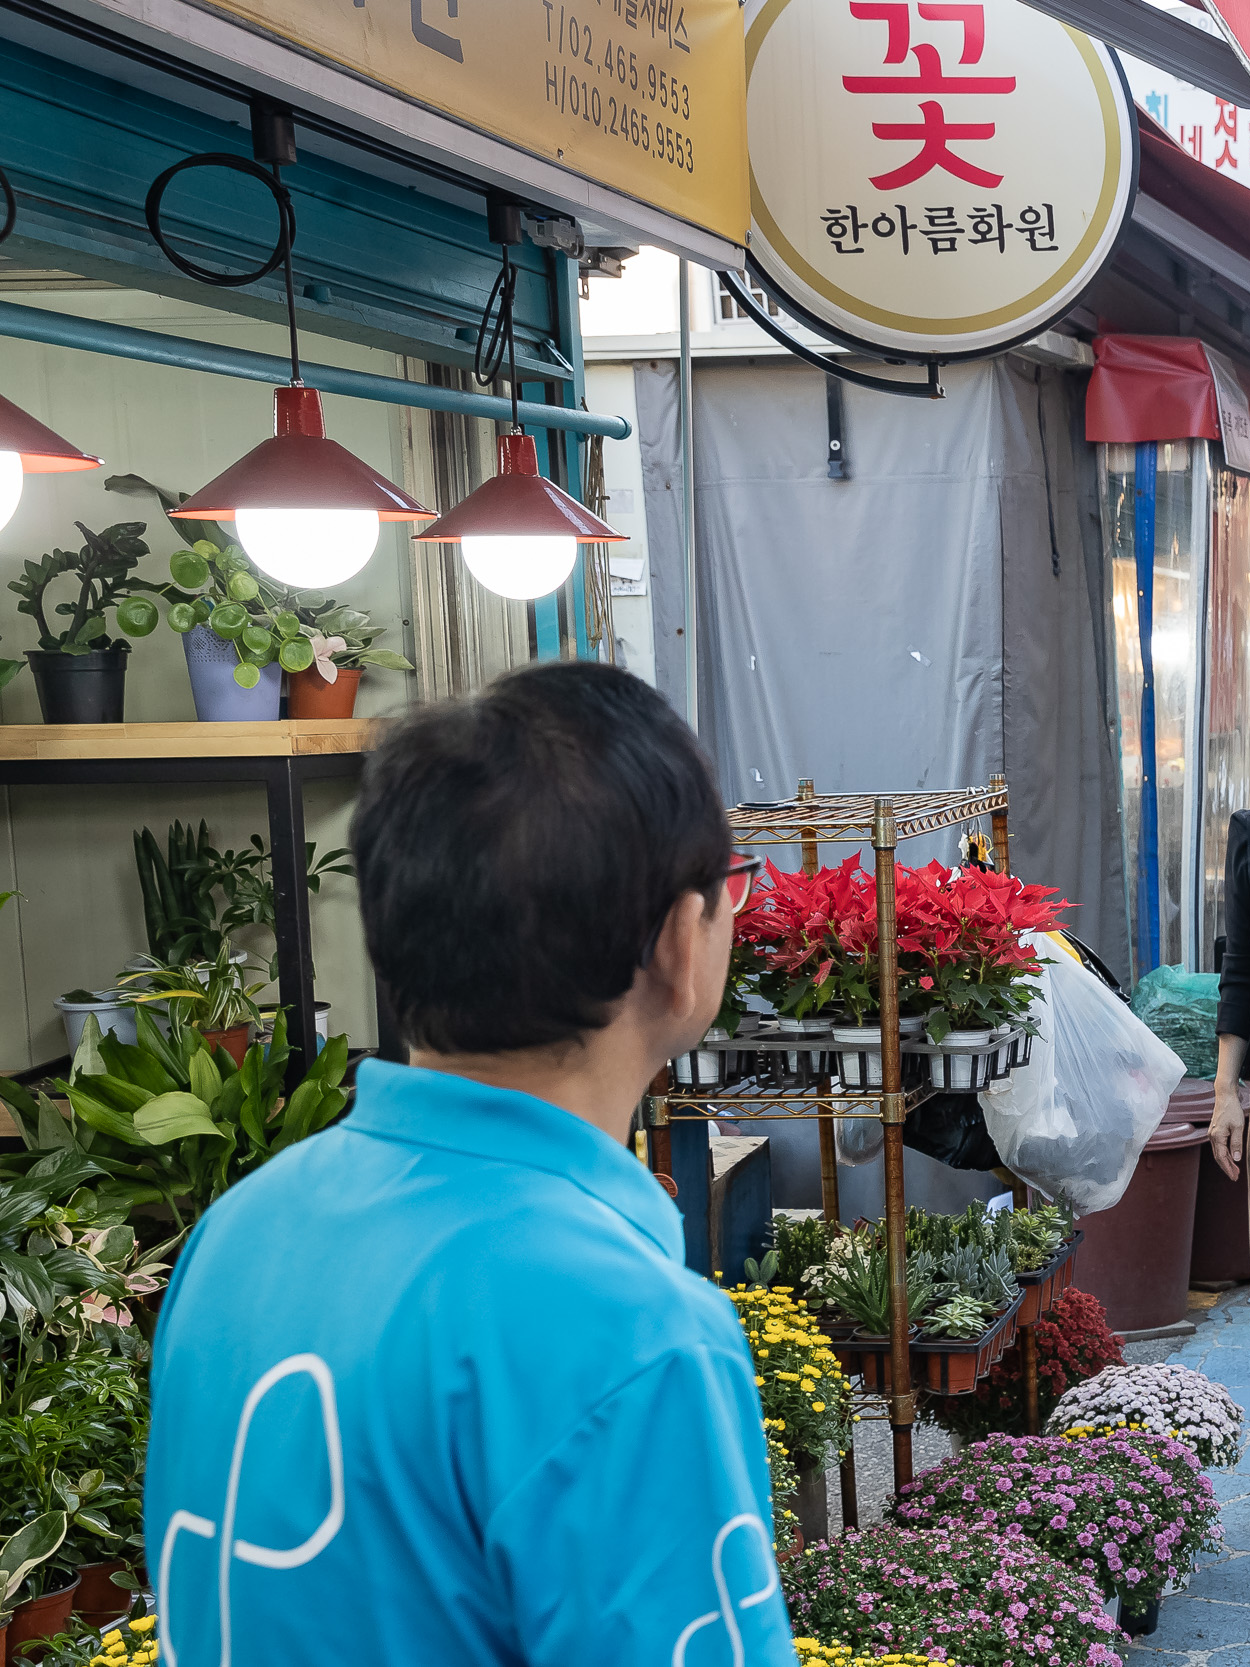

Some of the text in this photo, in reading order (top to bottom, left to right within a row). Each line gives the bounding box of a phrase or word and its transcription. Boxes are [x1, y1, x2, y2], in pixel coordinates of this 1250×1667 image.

[543, 0, 690, 121] T/02.465.9553
[545, 60, 694, 174] H/010.2465.9553
[842, 1, 1017, 190] 꽃
[820, 203, 1059, 255] 한아름화원
